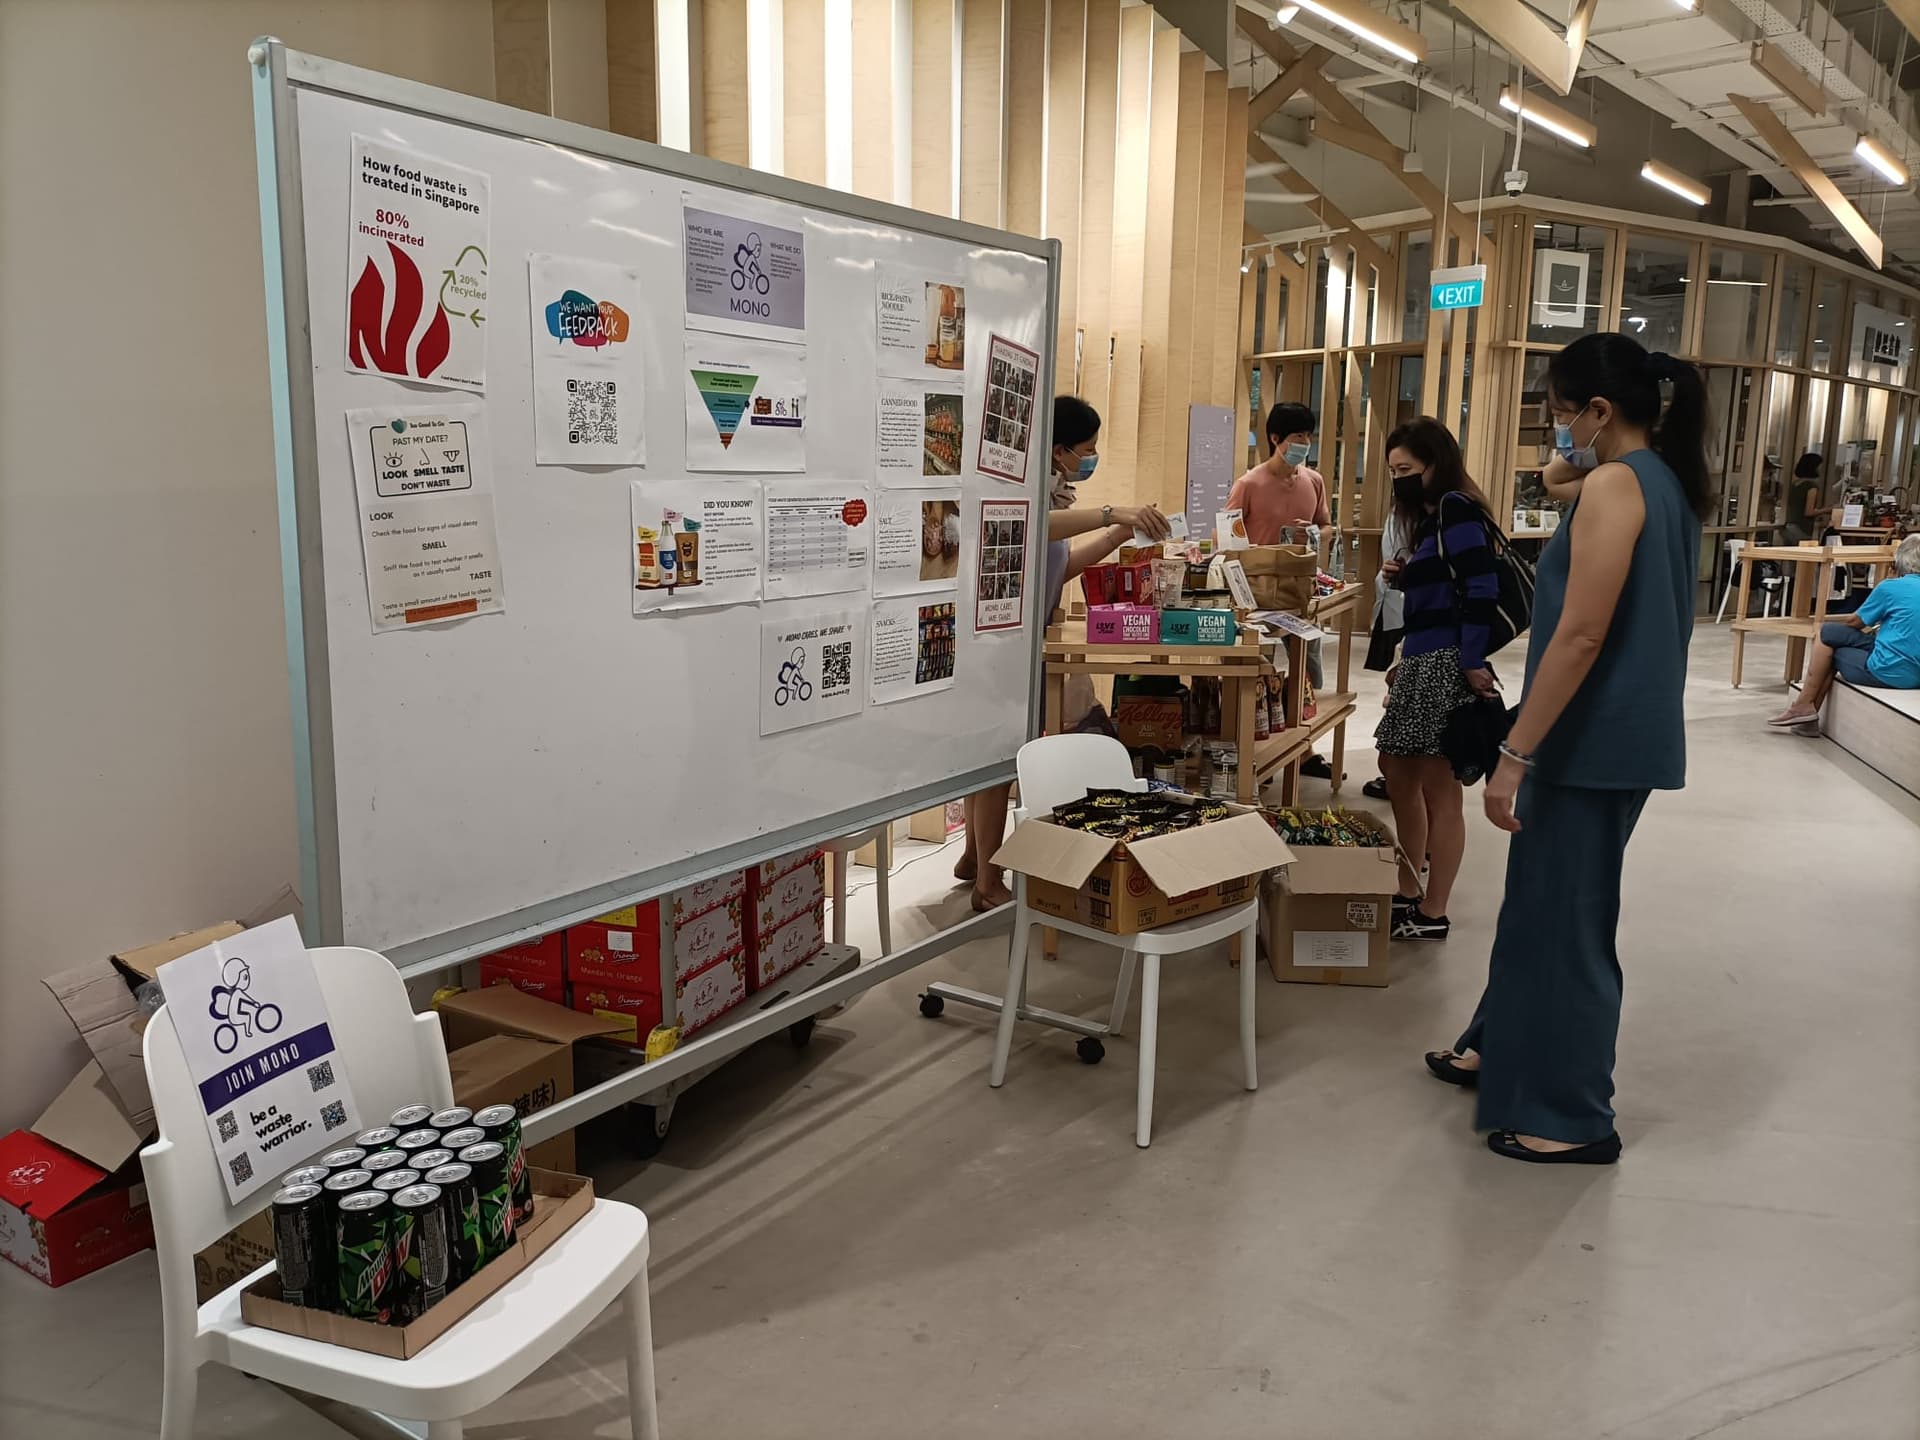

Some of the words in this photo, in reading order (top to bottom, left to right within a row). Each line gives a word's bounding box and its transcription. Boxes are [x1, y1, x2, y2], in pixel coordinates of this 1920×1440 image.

[362, 156, 391, 174] How
[393, 164, 421, 182] food
[424, 175, 456, 193] waste
[458, 183, 468, 197] is
[362, 172, 408, 194] treated
[411, 184, 422, 198] in
[424, 188, 480, 215] Singapore
[375, 208, 409, 229] 80%
[359, 221, 424, 247] incinerated
[687, 224, 703, 234] WHO
[713, 230, 724, 238] ARE
[459, 274, 479, 287] 20%
[451, 284, 487, 300] recycled
[1445, 285, 1476, 304] EXIT
[560, 301, 572, 313] WE
[573, 302, 596, 313] WANT
[730, 297, 770, 317] MONO
[558, 313, 618, 338] FEEDBACK
[392, 437, 411, 446] PAST
[412, 436, 424, 445] MY
[425, 434, 449, 444] DATE?
[383, 470, 408, 480] LOOK
[413, 467, 439, 477] SMELL
[441, 464, 465, 474] TASTE
[401, 481, 425, 491] DON'T
[426, 478, 451, 488] WASTE
[703, 501, 715, 509] DID
[717, 501, 729, 509] YOU
[730, 500, 753, 509] KNOW?
[369, 512, 394, 522] LOOK
[417, 525, 426, 533] for
[422, 540, 447, 551] SMELL
[469, 570, 492, 581] TASTE
[1122, 615, 1151, 625] VEGAN
[1198, 616, 1226, 627] VEGAN
[1122, 625, 1150, 633] CHOCOLATE
[1198, 626, 1226, 634] CHOCOLATE
[580, 966, 614, 978] Mandarin
[616, 972, 643, 983] Orange
[225, 1066, 254, 1094] JOIN
[259, 1043, 300, 1076] MONO
[250, 1110, 267, 1126] be
[267, 1105, 278, 1118] a
[256, 1112, 293, 1139] waste
[260, 1120, 313, 1153] warrior.
